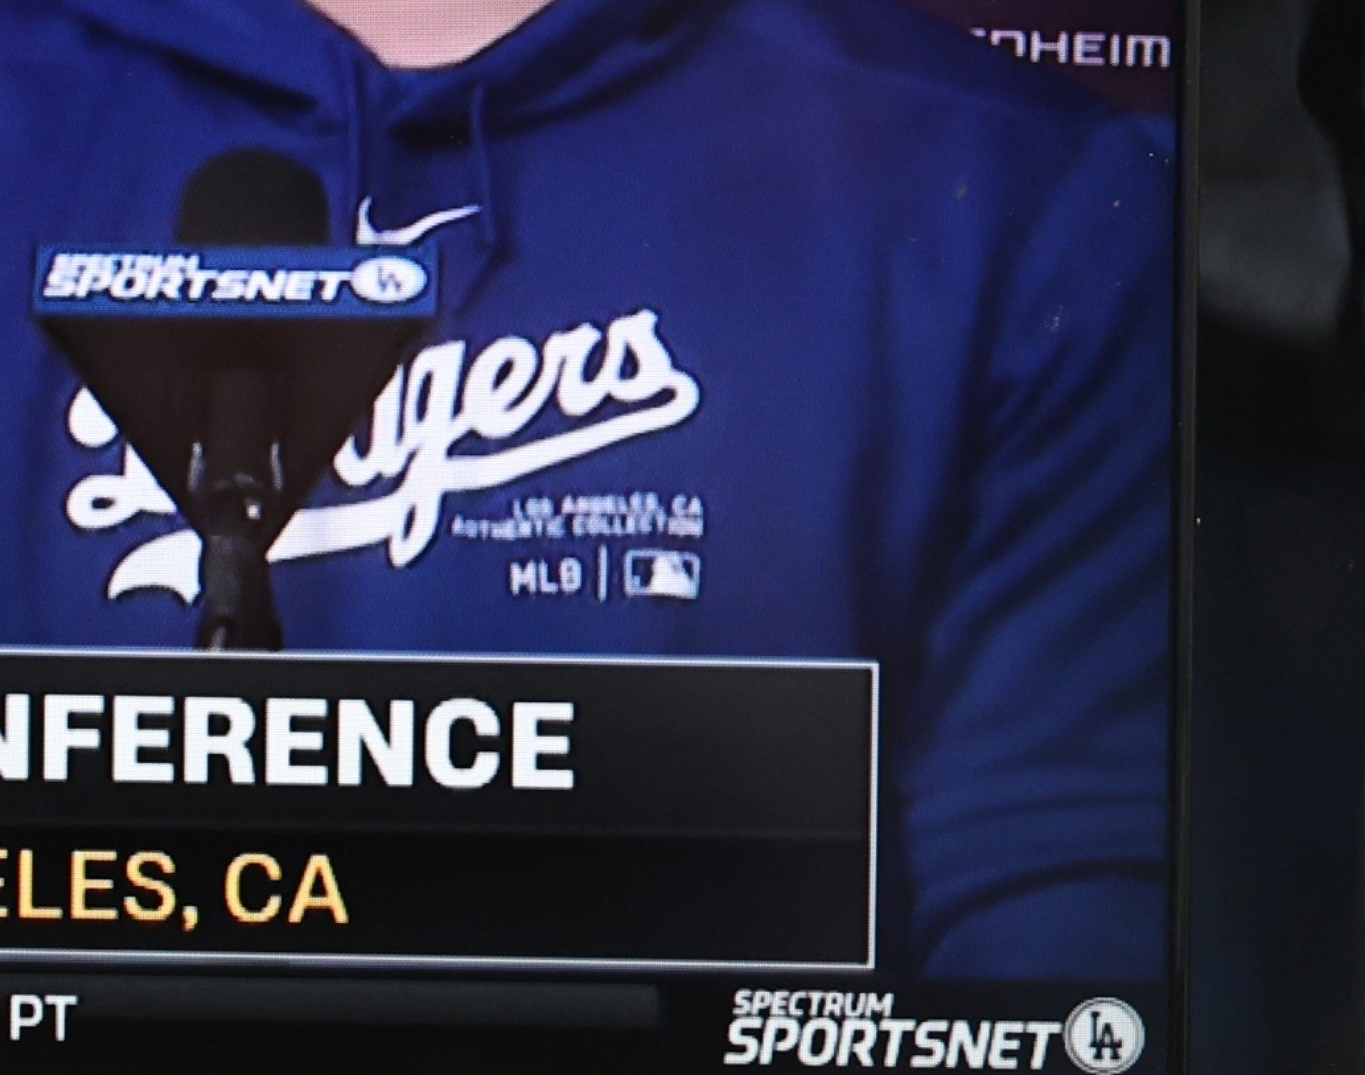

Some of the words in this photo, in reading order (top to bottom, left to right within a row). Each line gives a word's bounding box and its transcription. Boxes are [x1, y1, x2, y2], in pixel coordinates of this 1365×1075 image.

[973, 29, 1170, 67] NHEIM
[42, 270, 352, 302] SPORTSNET
[511, 557, 582, 594] MLB
[225, 853, 348, 924] CA
[10, 994, 78, 1041] PT
[731, 988, 895, 1017] SPECTRUM
[723, 1017, 1063, 1070] SPORTSNET
